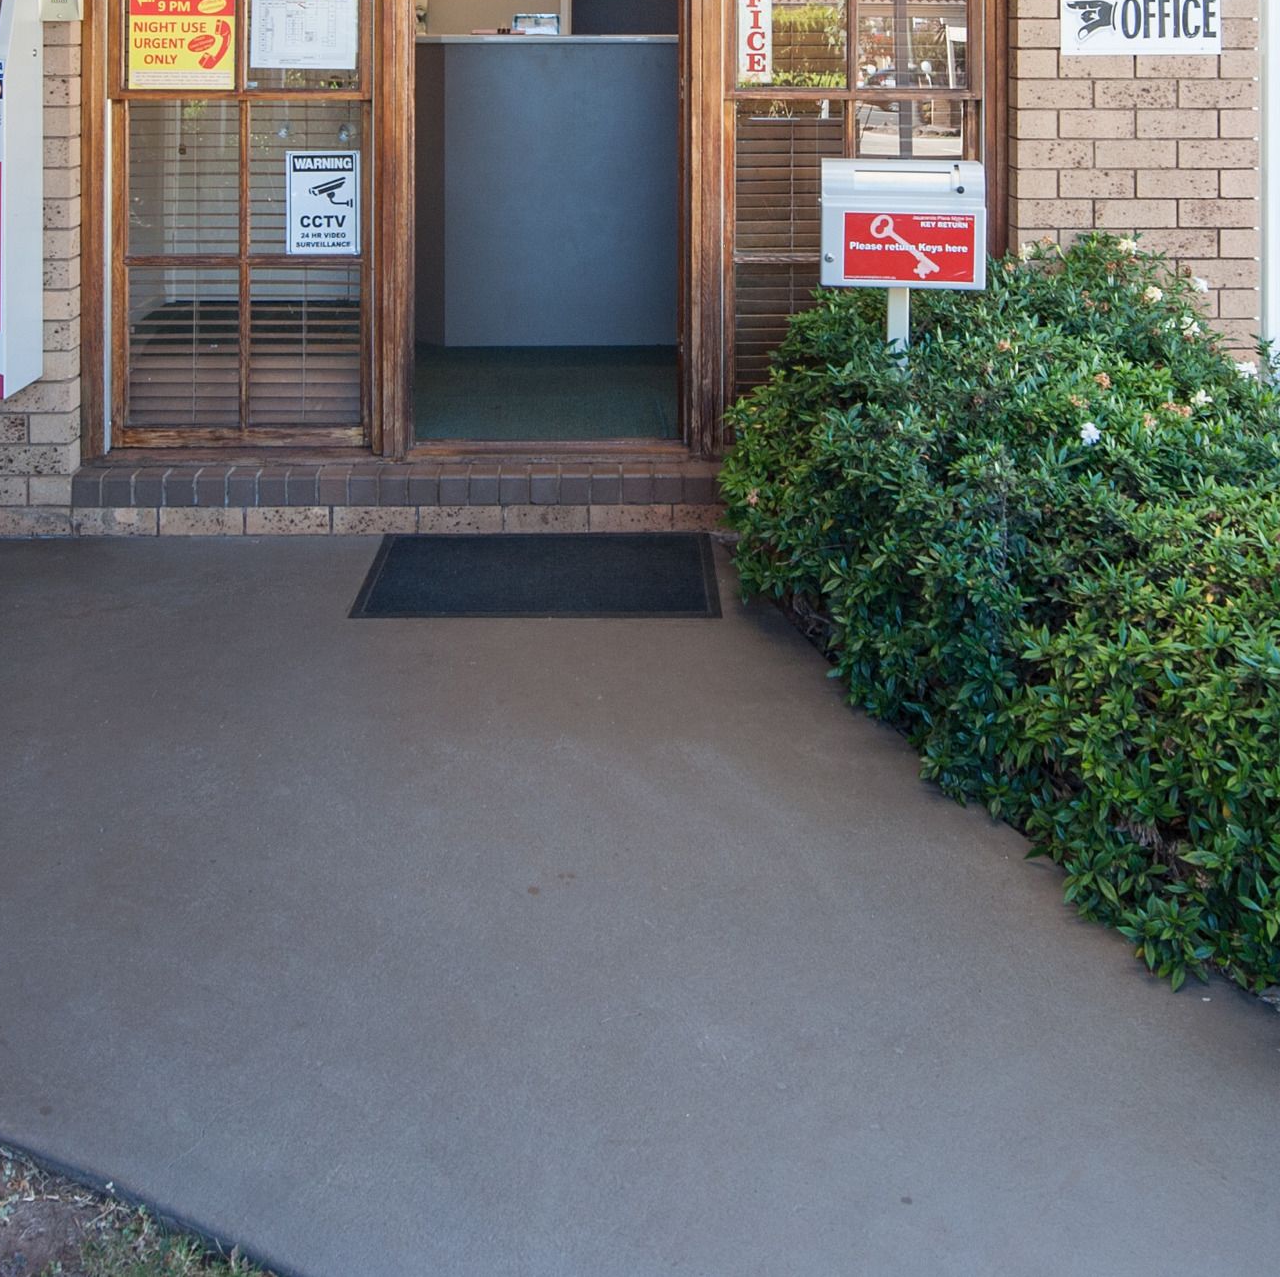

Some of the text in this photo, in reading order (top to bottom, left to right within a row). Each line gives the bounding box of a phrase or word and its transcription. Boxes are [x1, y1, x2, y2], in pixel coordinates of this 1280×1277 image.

[158, 1, 166, 12] 9
[170, 1, 191, 12] PM
[133, 22, 206, 33] NIGHT USE
[134, 38, 185, 49] URGENT
[144, 54, 178, 64] ONLY
[294, 157, 353, 169] WARNING
[300, 215, 346, 228] CCTV
[937, 221, 969, 229] RETURN
[849, 241, 968, 254] Please return Keys here
